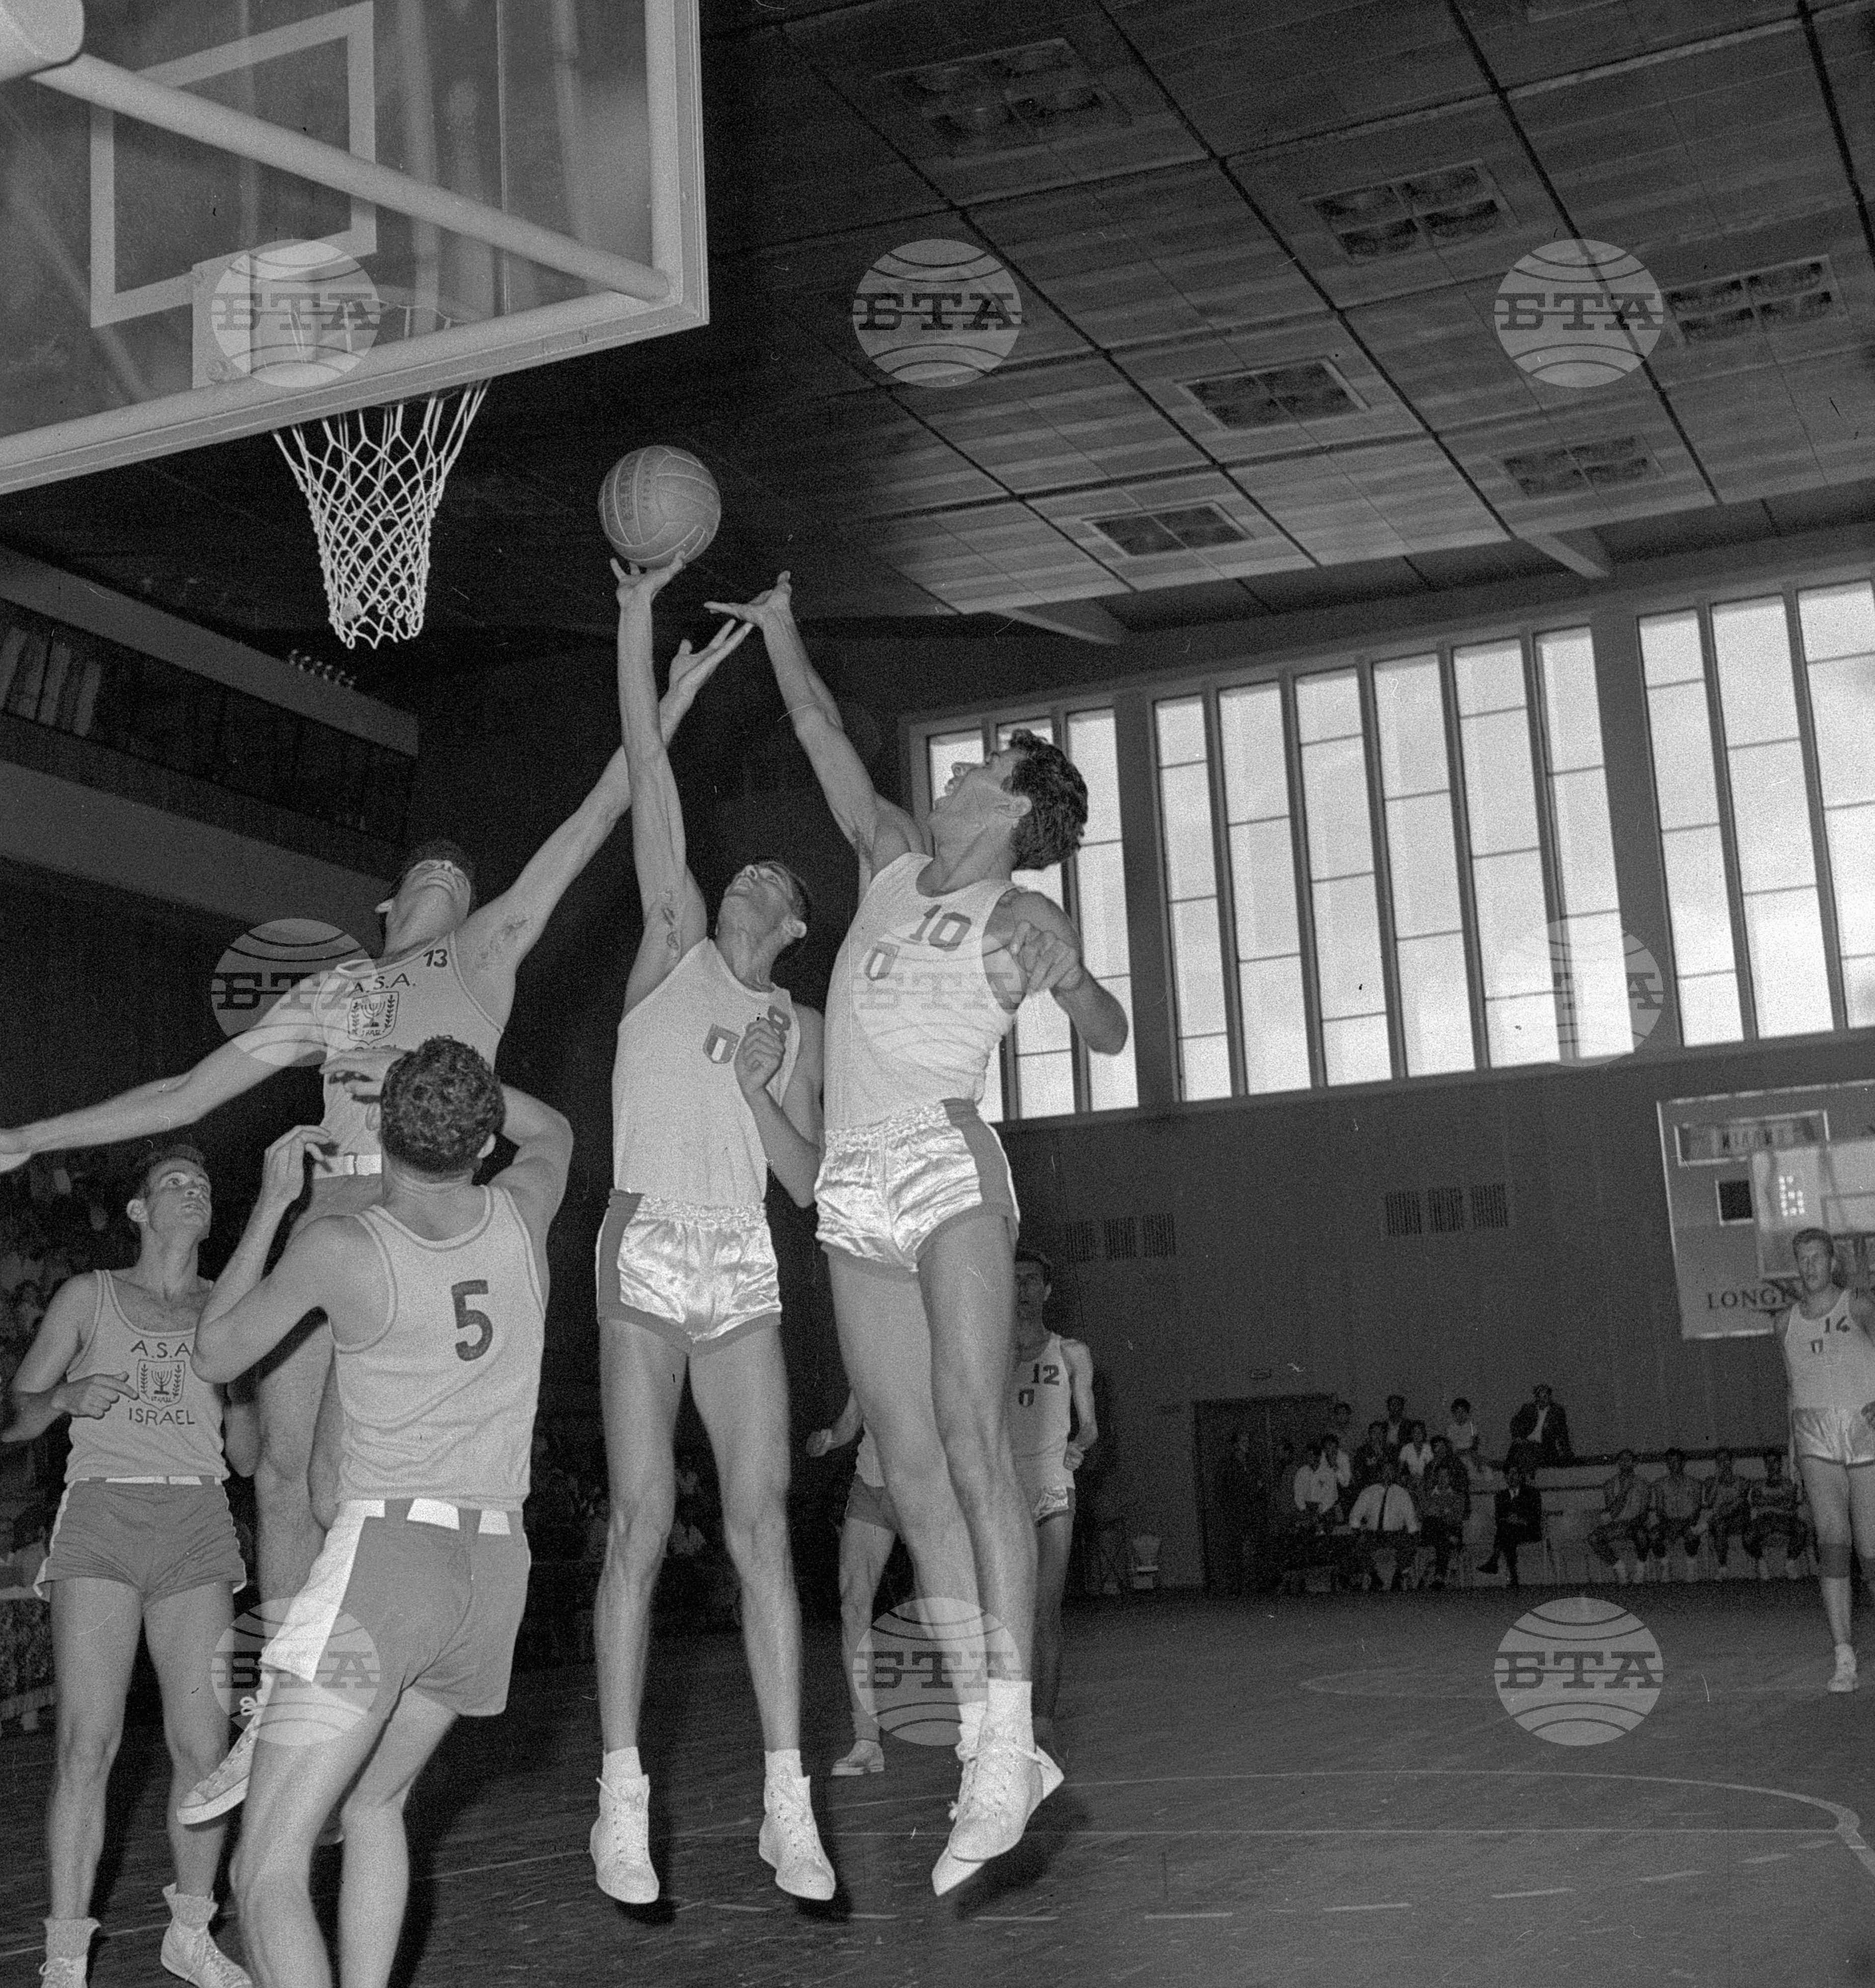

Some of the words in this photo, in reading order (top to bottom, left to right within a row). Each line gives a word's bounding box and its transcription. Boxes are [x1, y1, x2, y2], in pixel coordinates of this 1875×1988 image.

[909, 905, 972, 952] 10
[423, 949, 448, 968] 13
[1707, 1288, 1786, 1310] LONGI
[451, 1279, 493, 1361] 5
[1031, 1364, 1060, 1386] 12
[128, 1408, 195, 1426] ISRAEL
